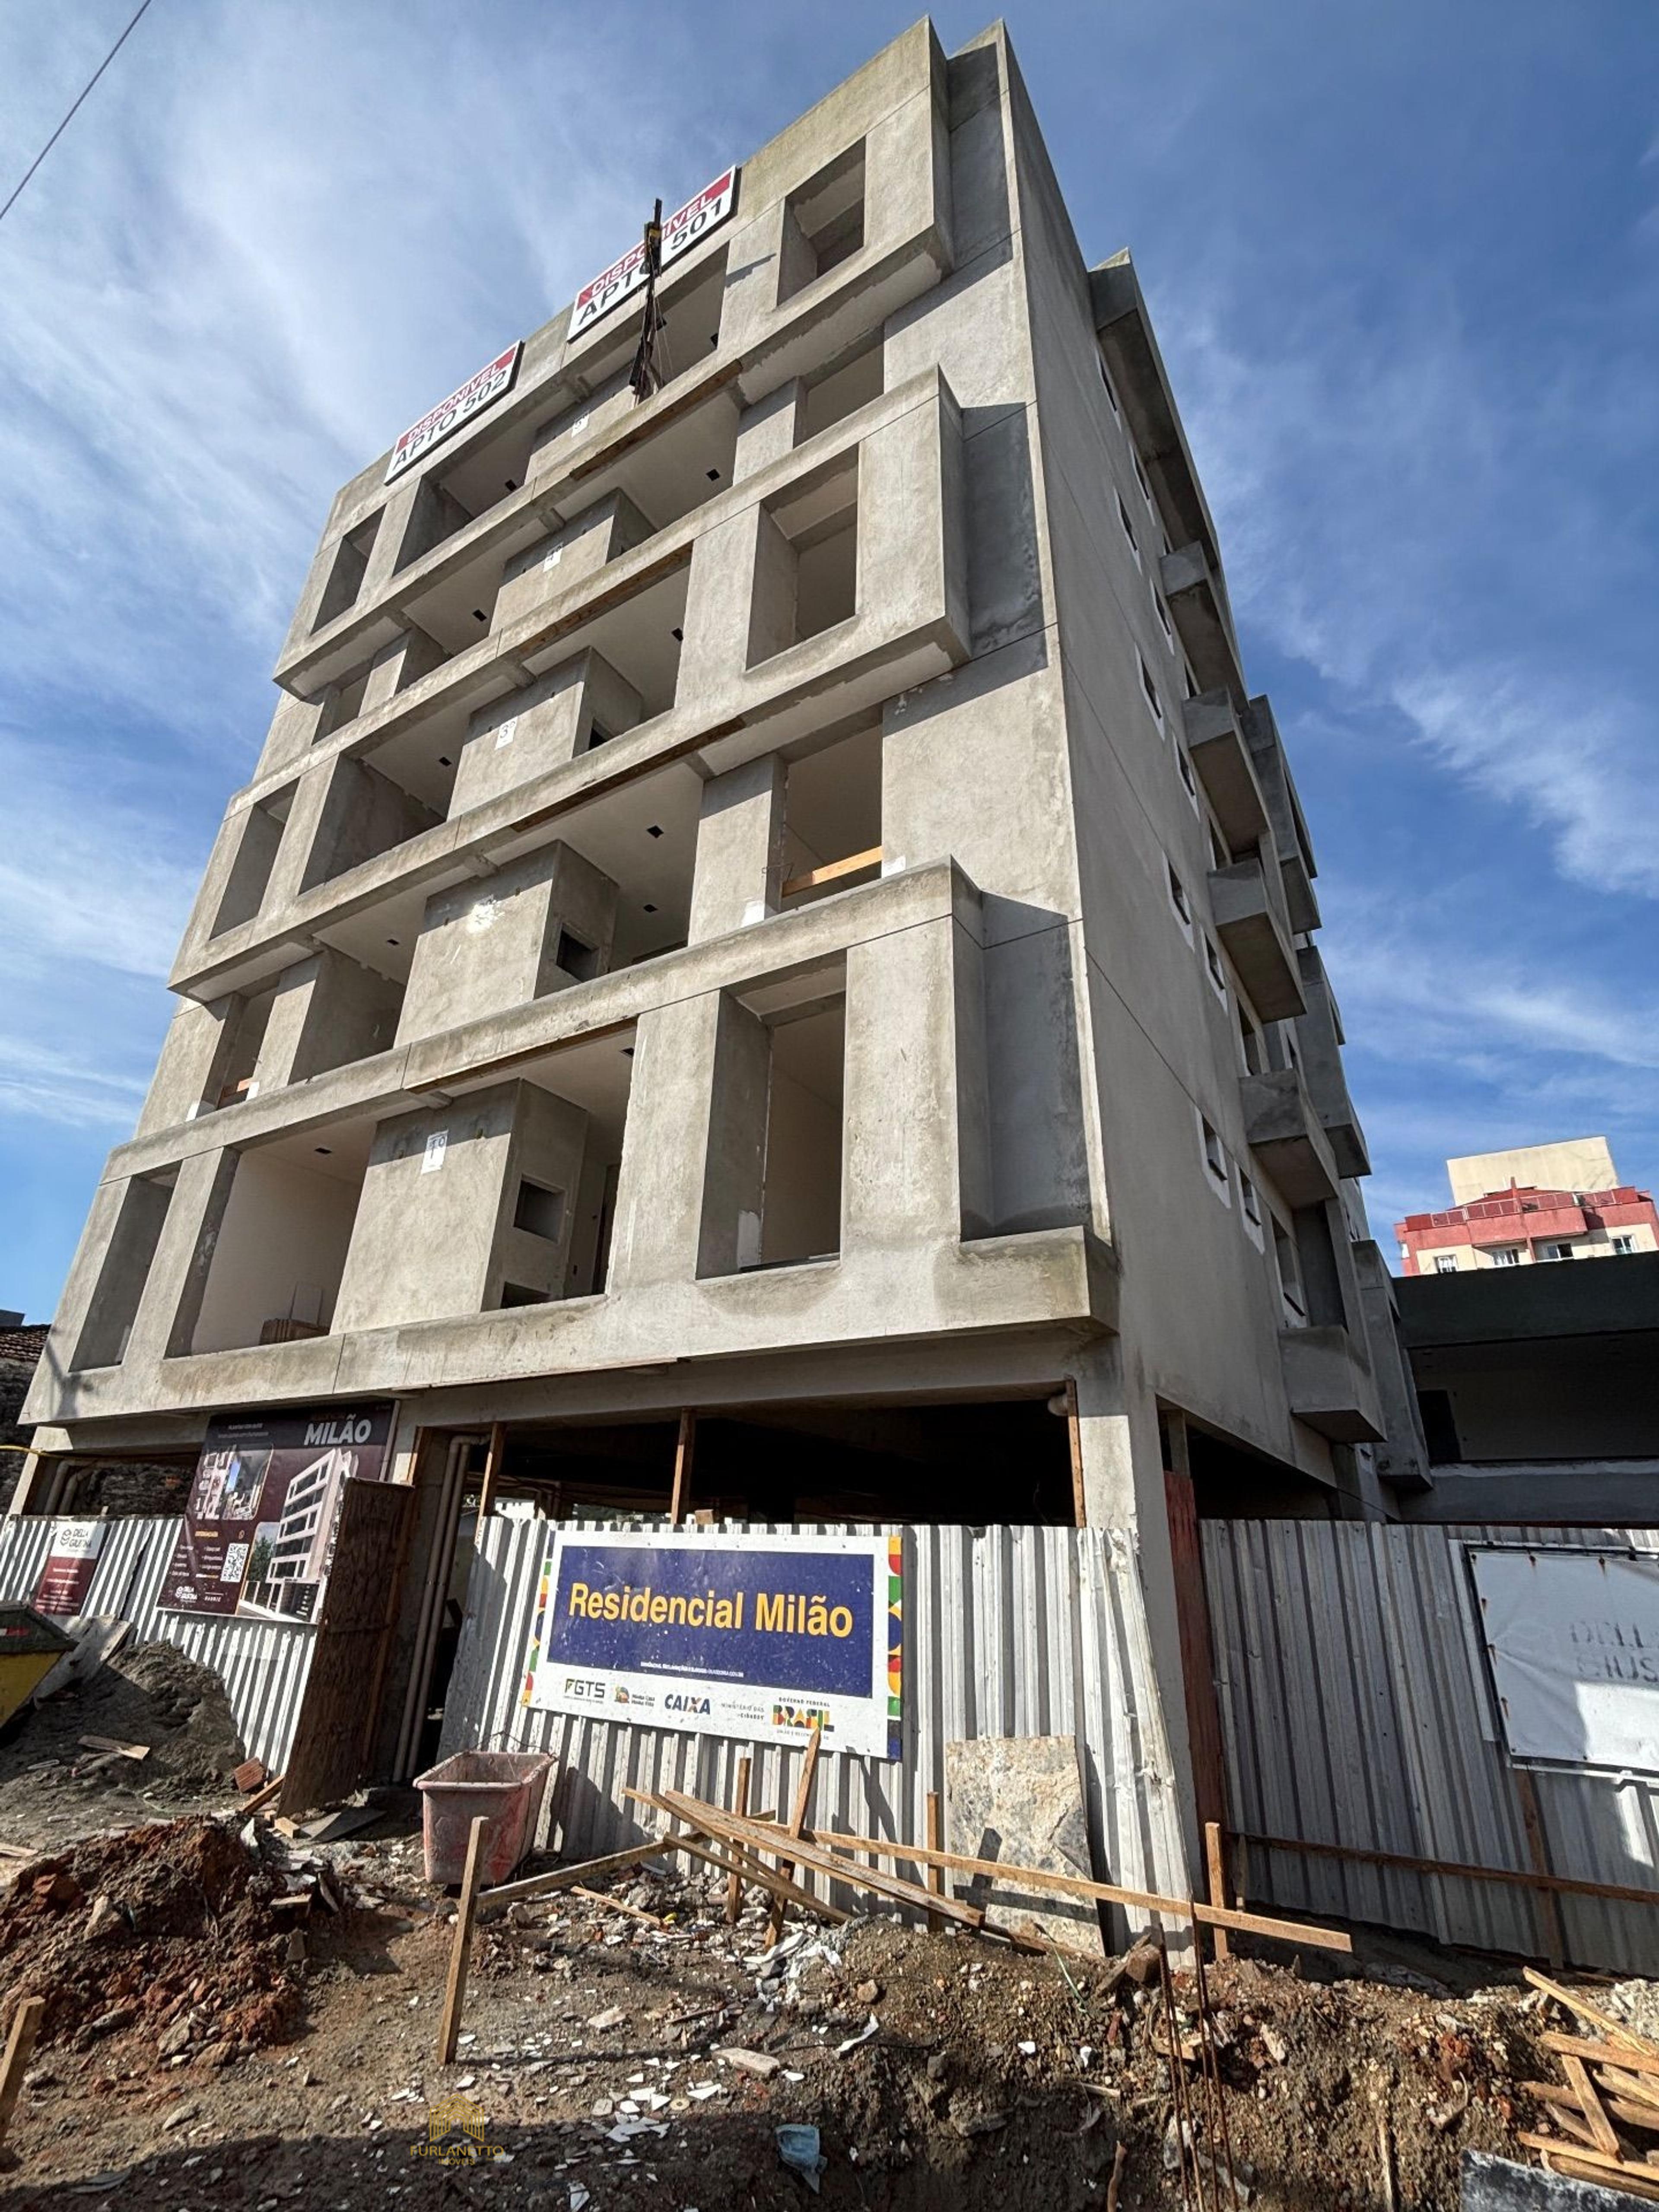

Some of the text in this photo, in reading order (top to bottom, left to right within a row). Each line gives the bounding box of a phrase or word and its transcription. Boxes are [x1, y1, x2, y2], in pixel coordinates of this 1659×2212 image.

[671, 197, 722, 250] 501
[393, 370, 506, 470] APTO 502
[304, 1413, 372, 1446] MILÃO
[569, 1581, 853, 1637] Residencial Milão
[565, 1678, 605, 1698] FGTS
[664, 1694, 710, 1715] CAIXA
[772, 1705, 835, 1732] BRASIL
